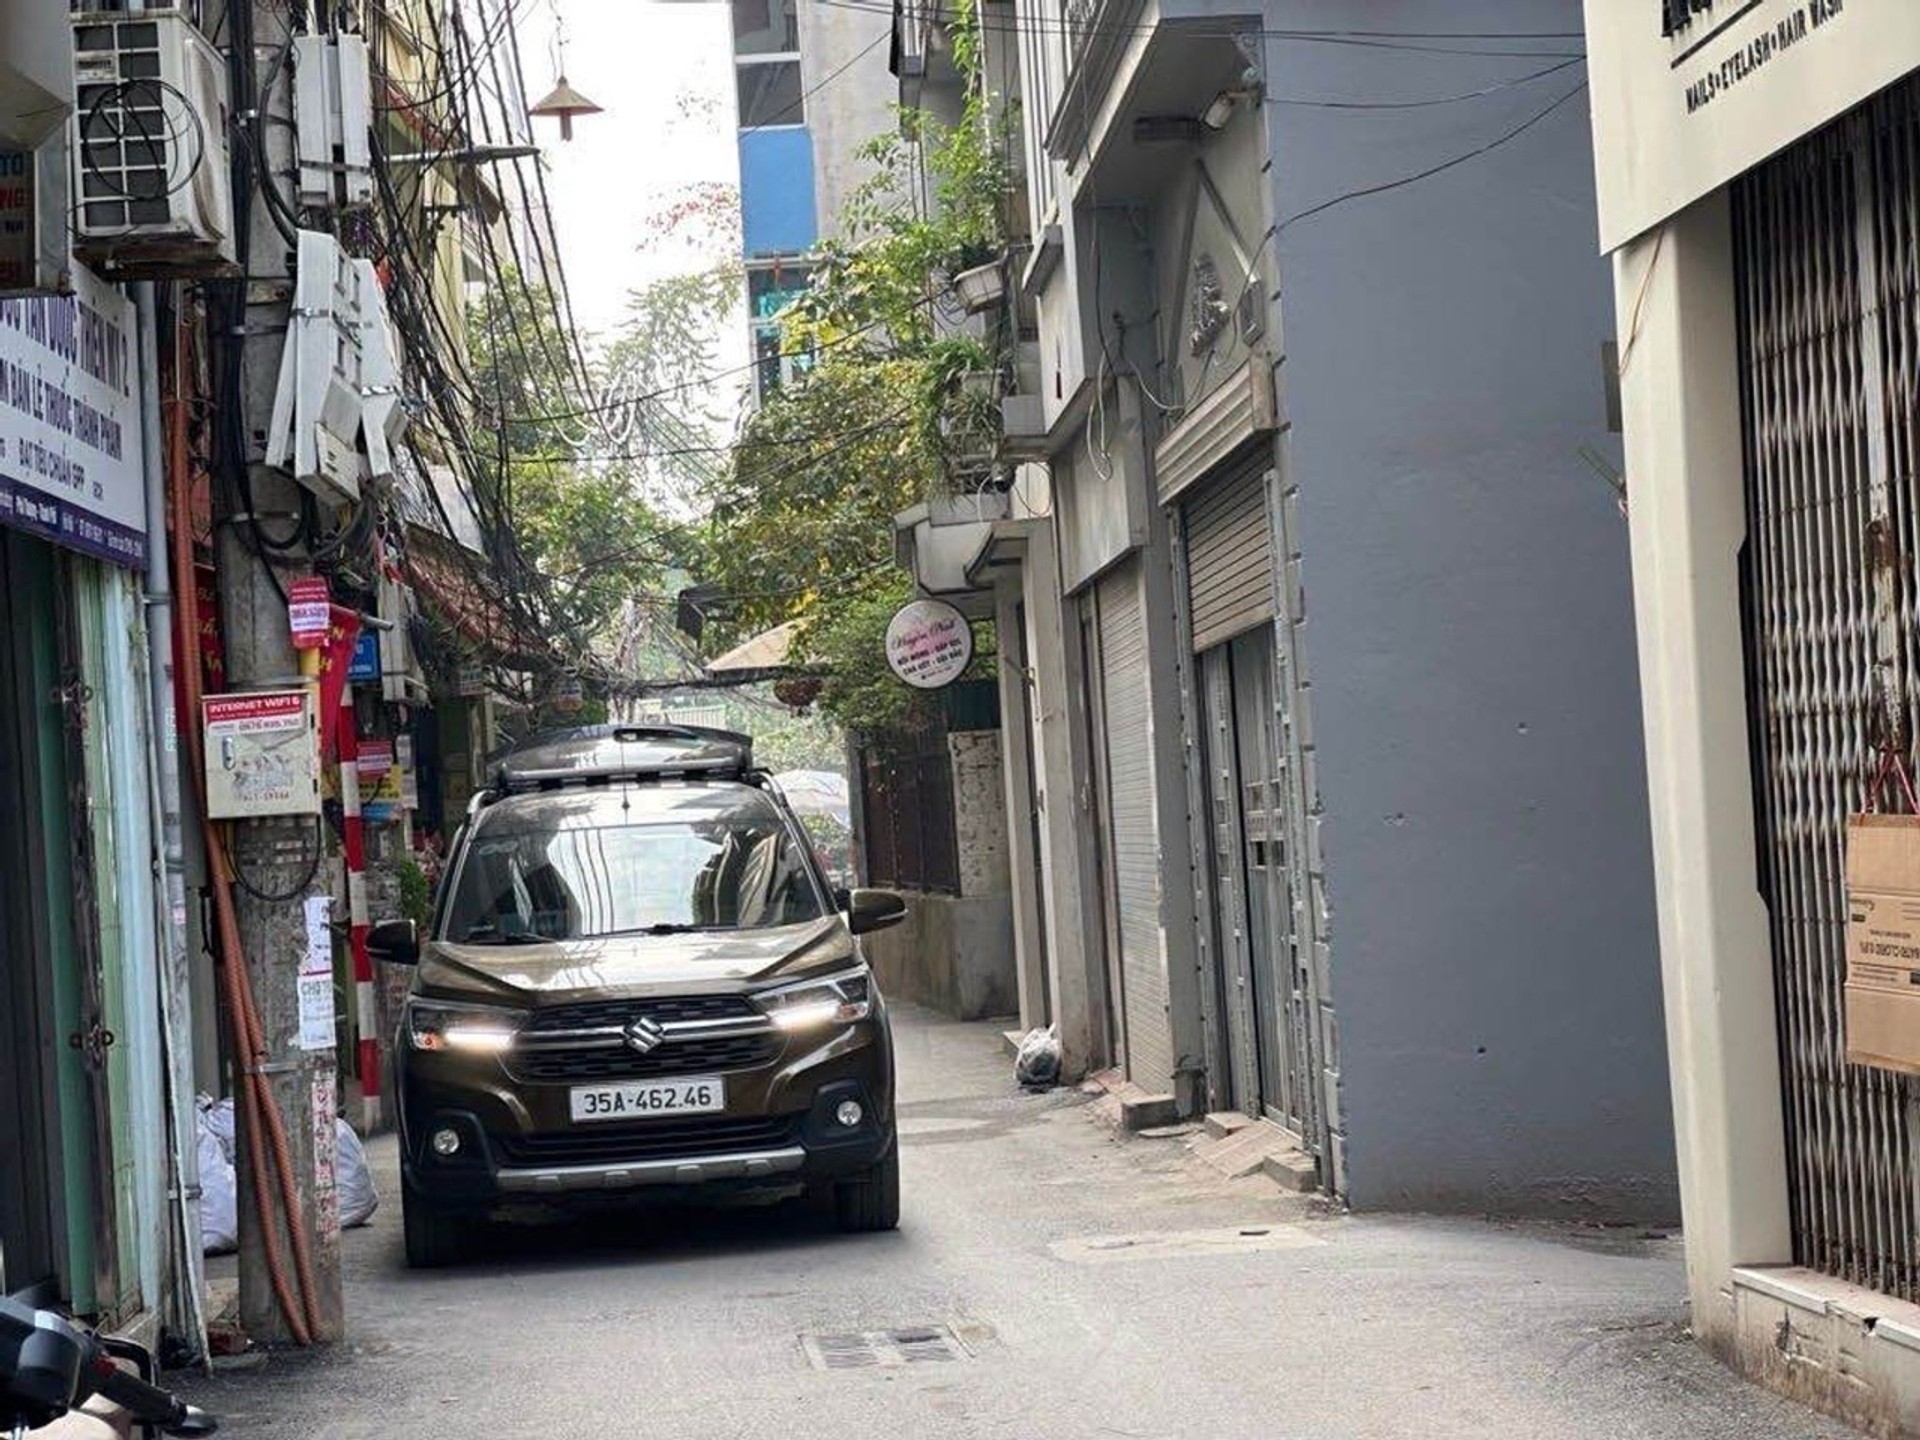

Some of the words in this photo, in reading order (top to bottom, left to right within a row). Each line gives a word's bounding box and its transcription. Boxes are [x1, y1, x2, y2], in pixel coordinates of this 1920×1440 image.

[1685, 71, 1717, 114] NAILS
[1721, 33, 1772, 90] EYELASH
[1777, 9, 1808, 51] HAIR
[209, 700, 262, 713] INTERNET
[584, 1086, 711, 1114] 35A-462.46
